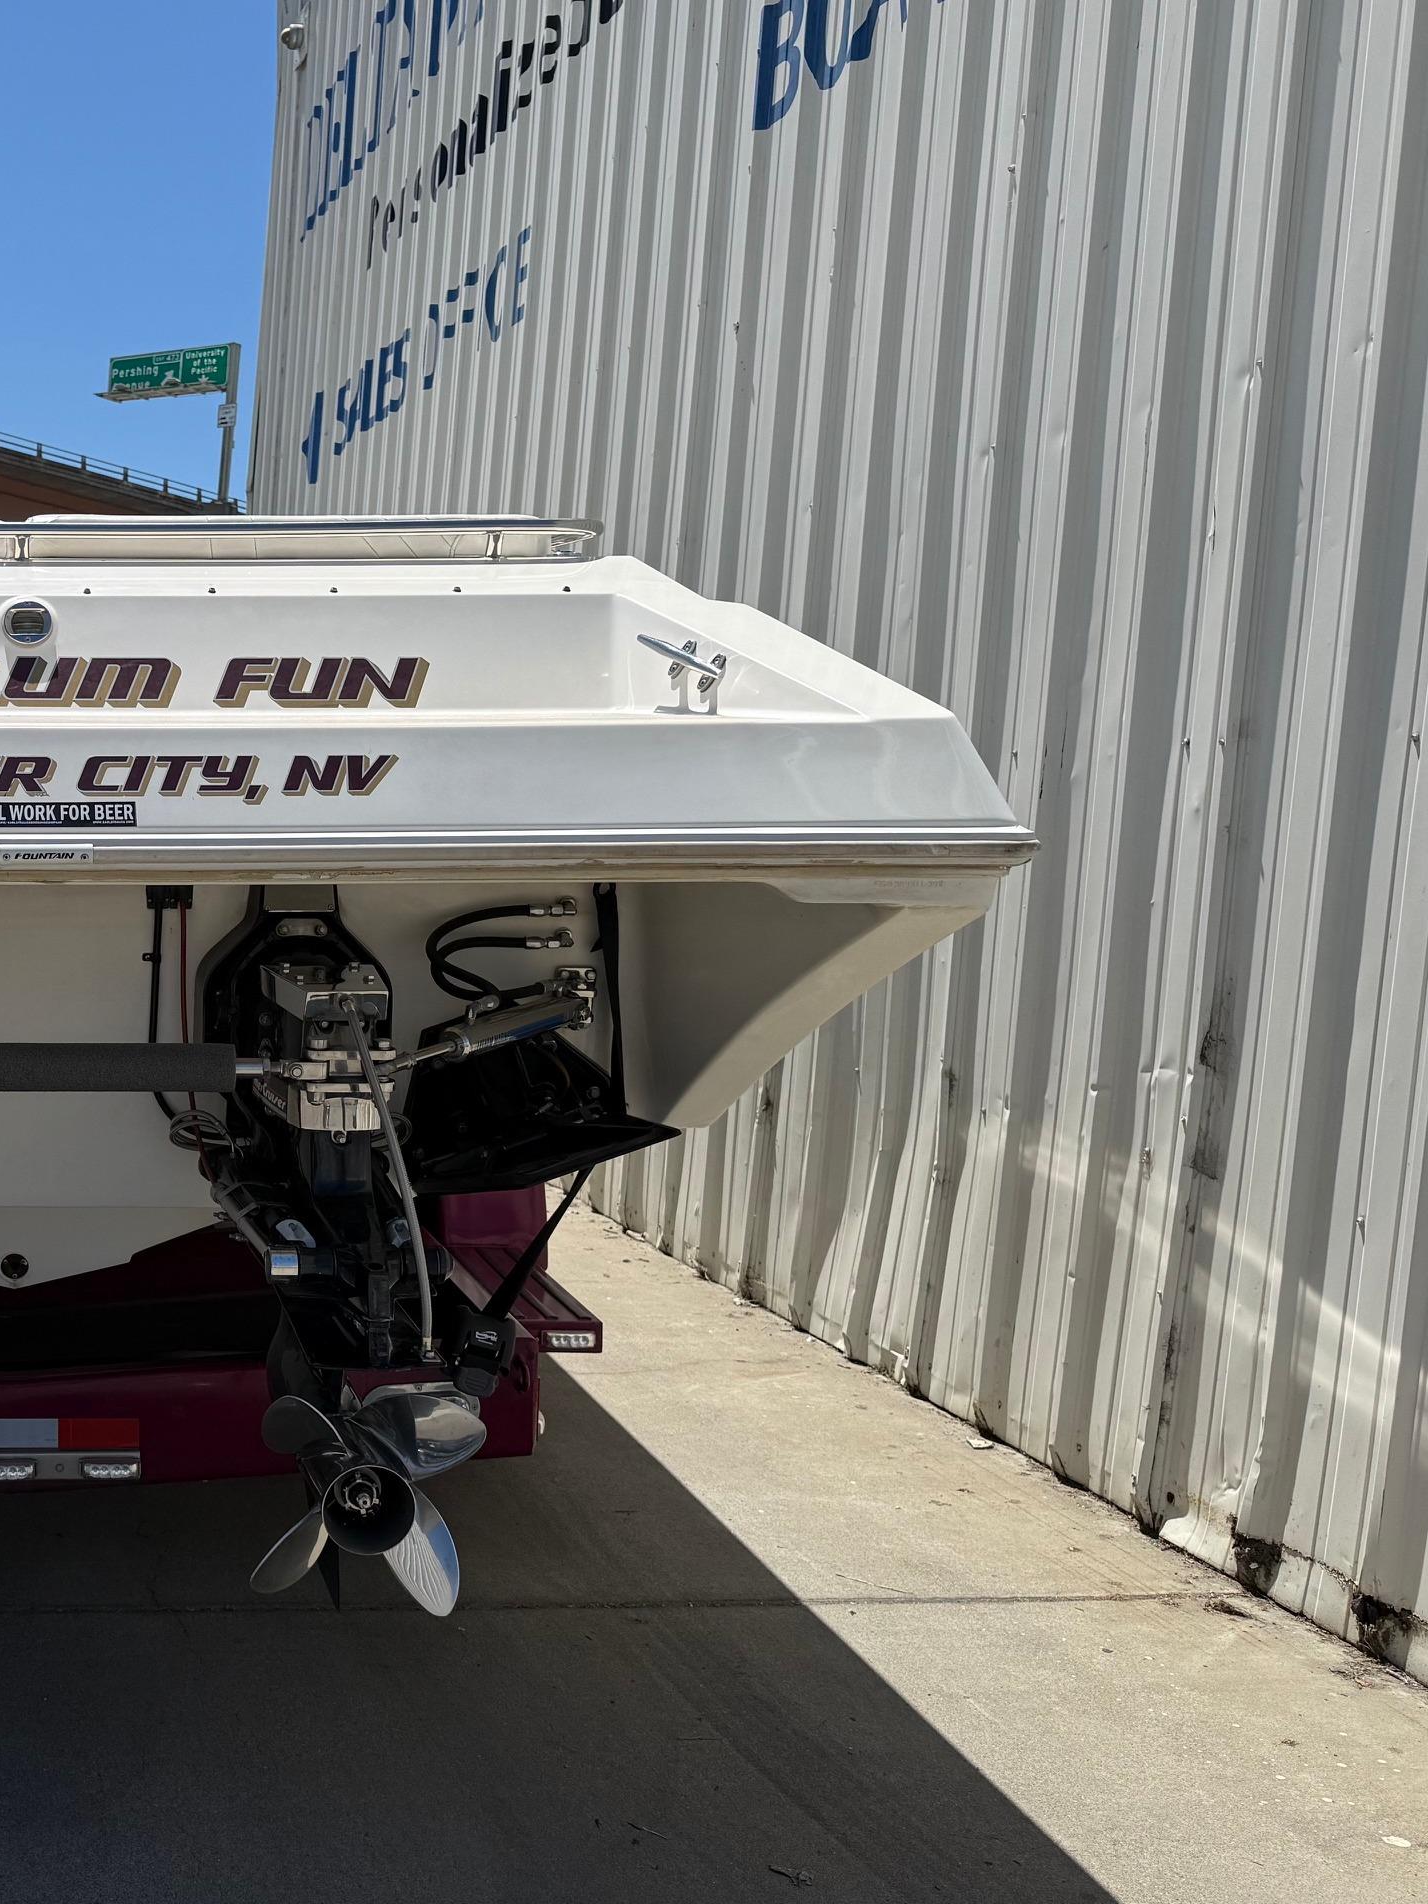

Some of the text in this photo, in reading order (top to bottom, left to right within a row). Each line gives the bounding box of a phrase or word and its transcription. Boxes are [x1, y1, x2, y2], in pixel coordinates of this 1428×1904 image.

[185, 349, 225, 360] University
[193, 359, 201, 367] of
[112, 365, 159, 378] Pershing
[191, 366, 218, 375] Pacific
[333, 328, 411, 456] SALES
[213, 655, 431, 708] FUN
[76, 755, 269, 805] CITY,
[281, 754, 400, 797] NV
[9, 804, 57, 821] WORK
[60, 804, 90, 821] FOR
[94, 804, 134, 821] BEER
[14, 852, 75, 860] FOUNTAIN
